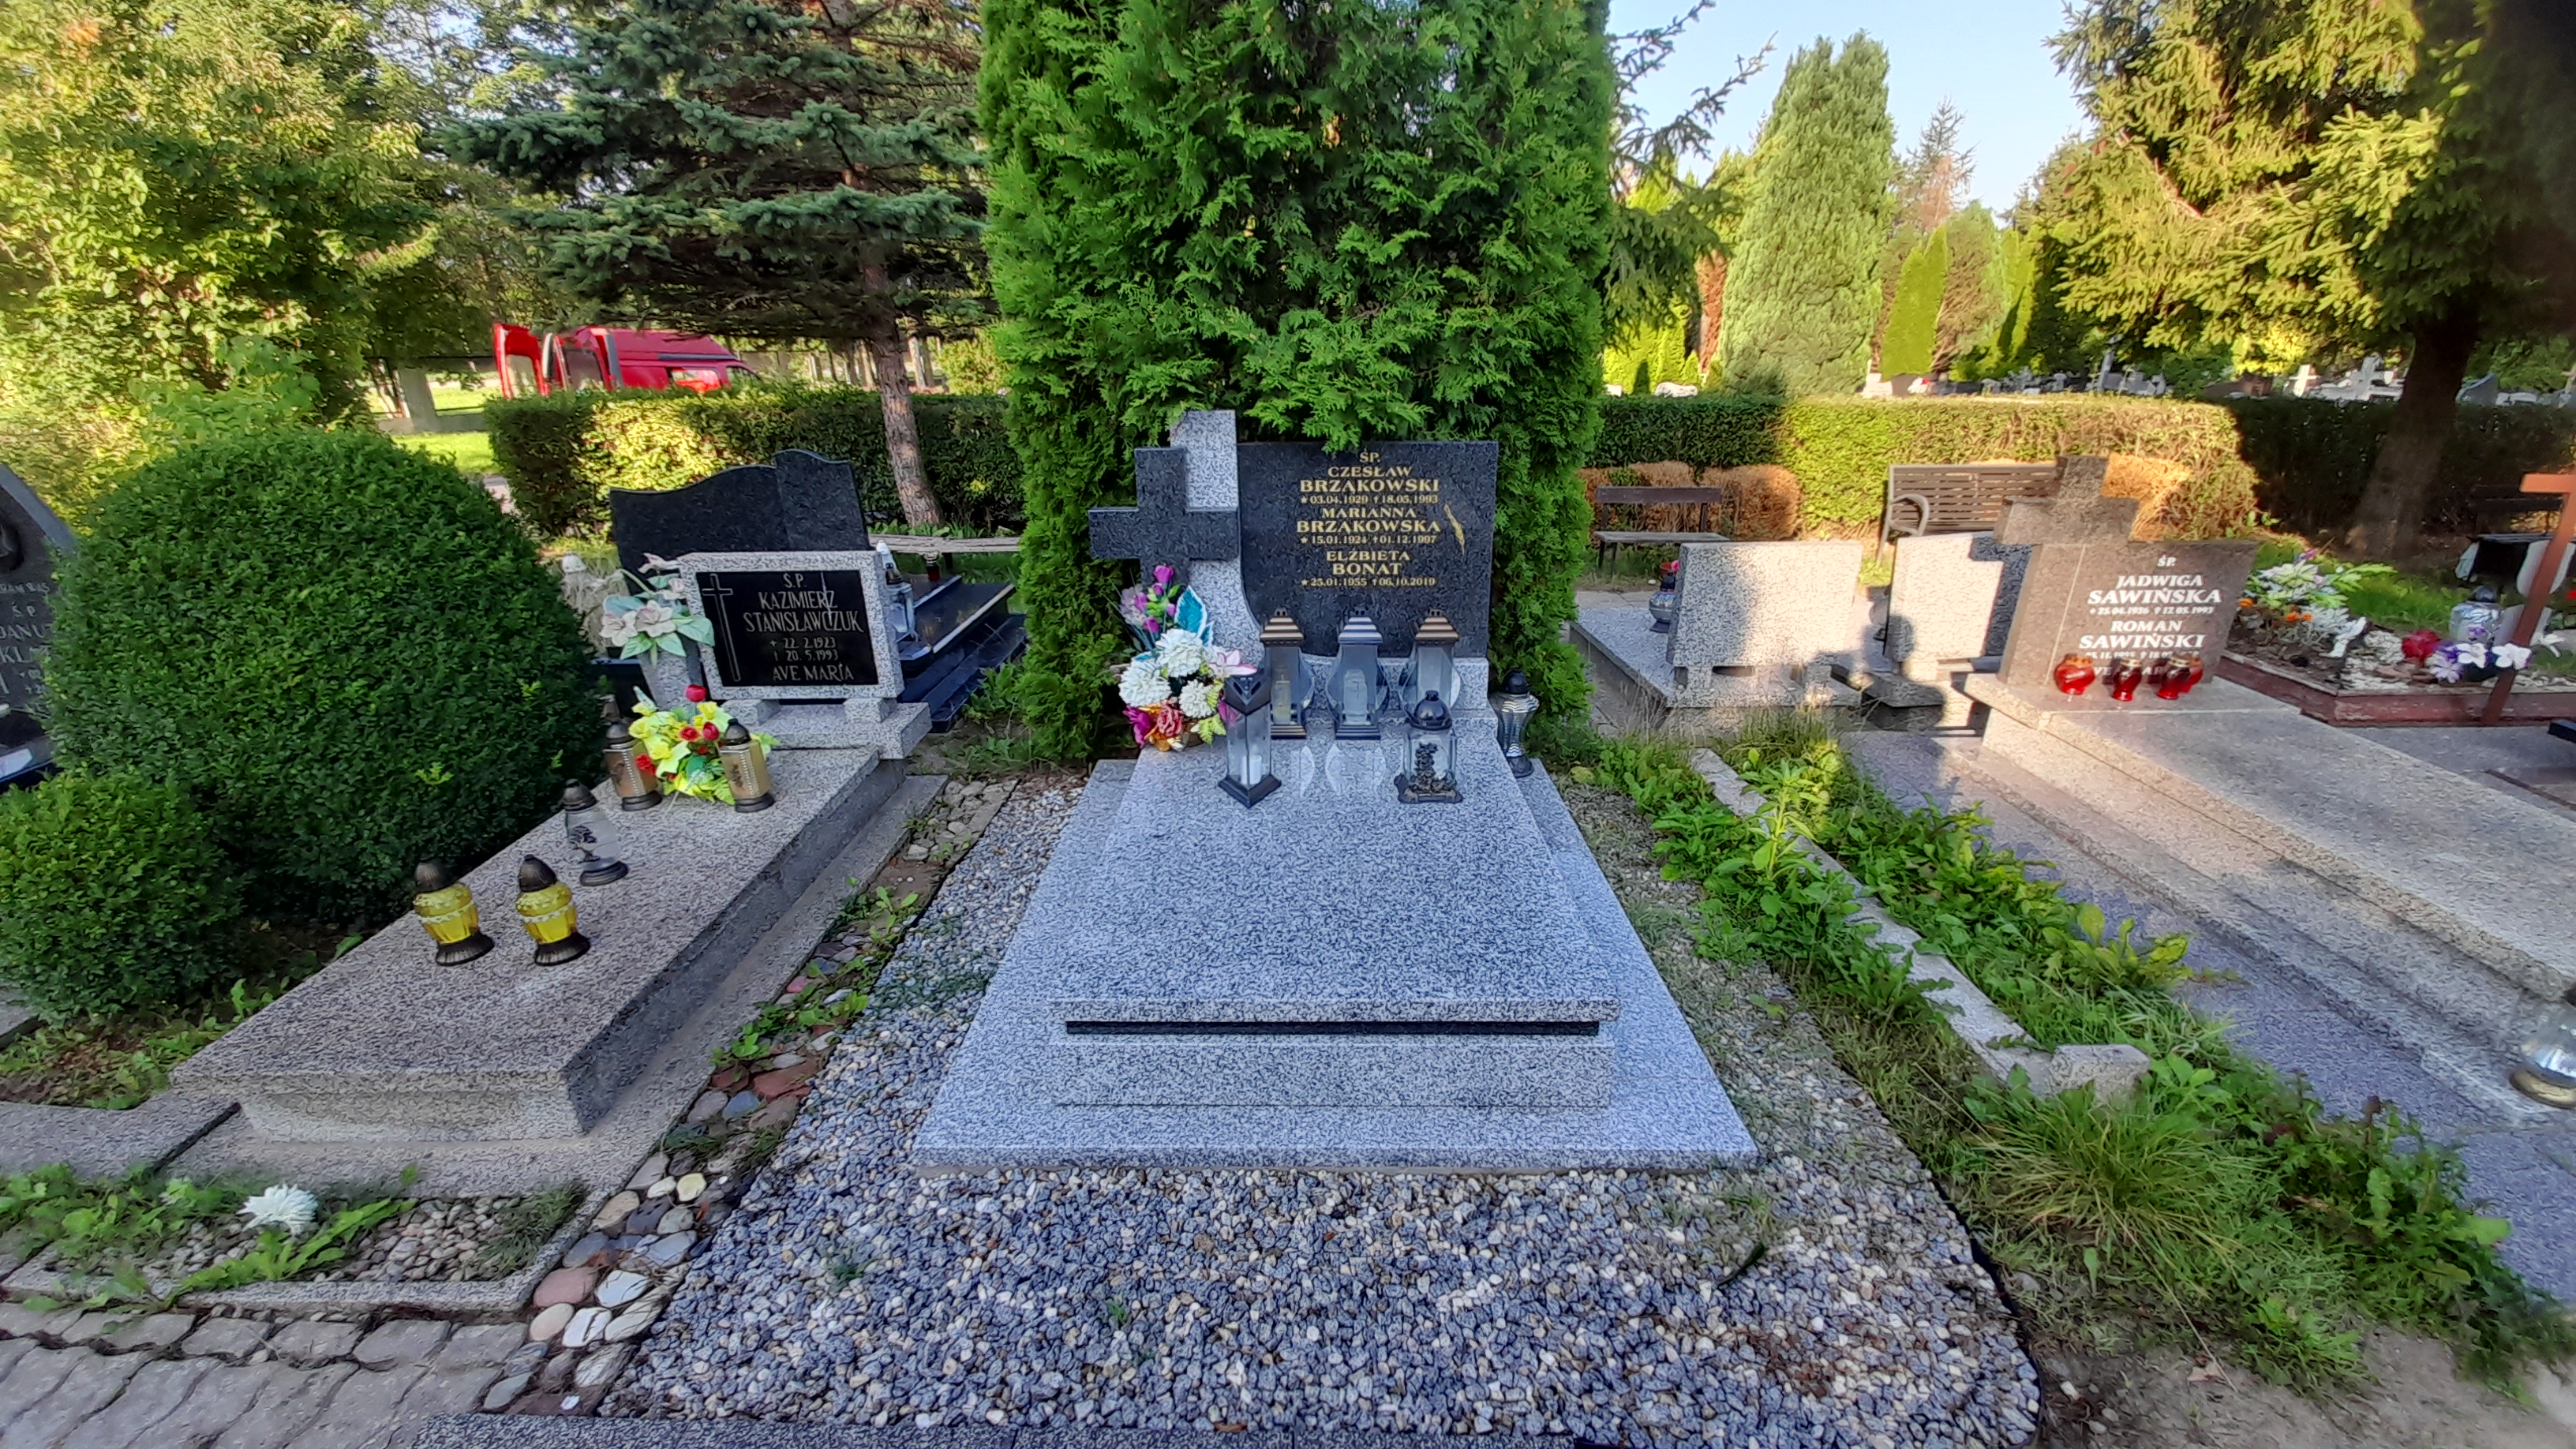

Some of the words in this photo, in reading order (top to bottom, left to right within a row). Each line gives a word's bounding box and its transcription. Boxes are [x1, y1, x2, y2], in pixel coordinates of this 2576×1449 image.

[1327, 466, 1412, 477] CZESŁAW
[1300, 479, 1440, 494] BRZĄKOWSKI
[1321, 507, 1417, 519] MARIANNA
[1297, 520, 1441, 534] BRZĄKOWSKA
[1327, 549, 1410, 561] ELŻBIETA
[1332, 563, 1402, 575] BONAT
[2115, 575, 2203, 589] JADWIGA
[758, 590, 838, 610] KAZIMIERZ
[2087, 588, 2222, 605] SAWIŃSKA
[743, 611, 865, 633] STANISŁAWCZUK
[2111, 620, 2183, 632] ROMAN
[2079, 632, 2206, 649] SAWIŃSKI
[773, 665, 801, 681] AVE
